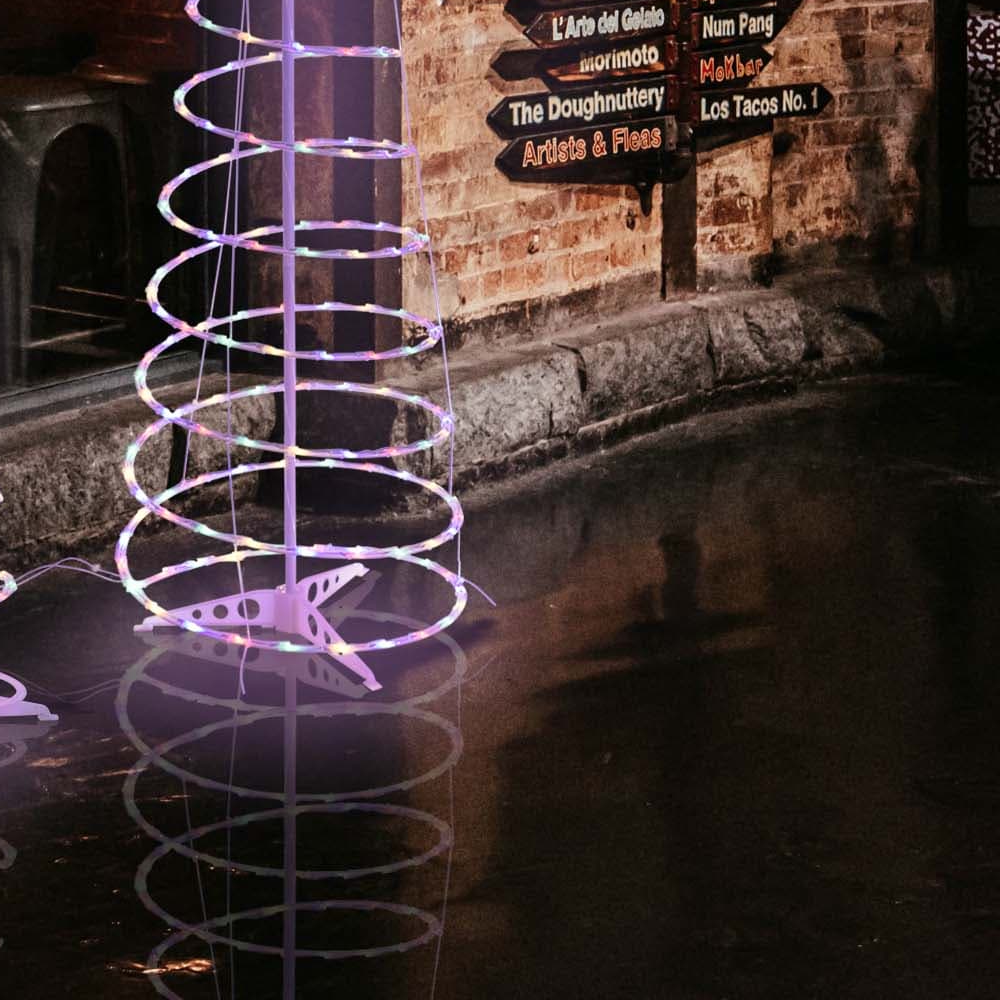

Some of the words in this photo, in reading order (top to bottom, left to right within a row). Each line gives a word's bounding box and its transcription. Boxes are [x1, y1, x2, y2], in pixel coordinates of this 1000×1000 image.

[597, 10, 620, 35] del
[621, 6, 665, 31] Gelato
[702, 15, 735, 39] Num
[738, 12, 774, 41] Pang
[509, 101, 544, 126] The
[548, 86, 665, 121] Doughnuttery
[701, 96, 729, 121] Los
[733, 94, 778, 119] Tacos
[782, 90, 807, 113] No.
[810, 87, 819, 109] 1
[522, 136, 587, 167] Artists
[592, 131, 607, 156] &
[612, 127, 662, 153] Fleas
